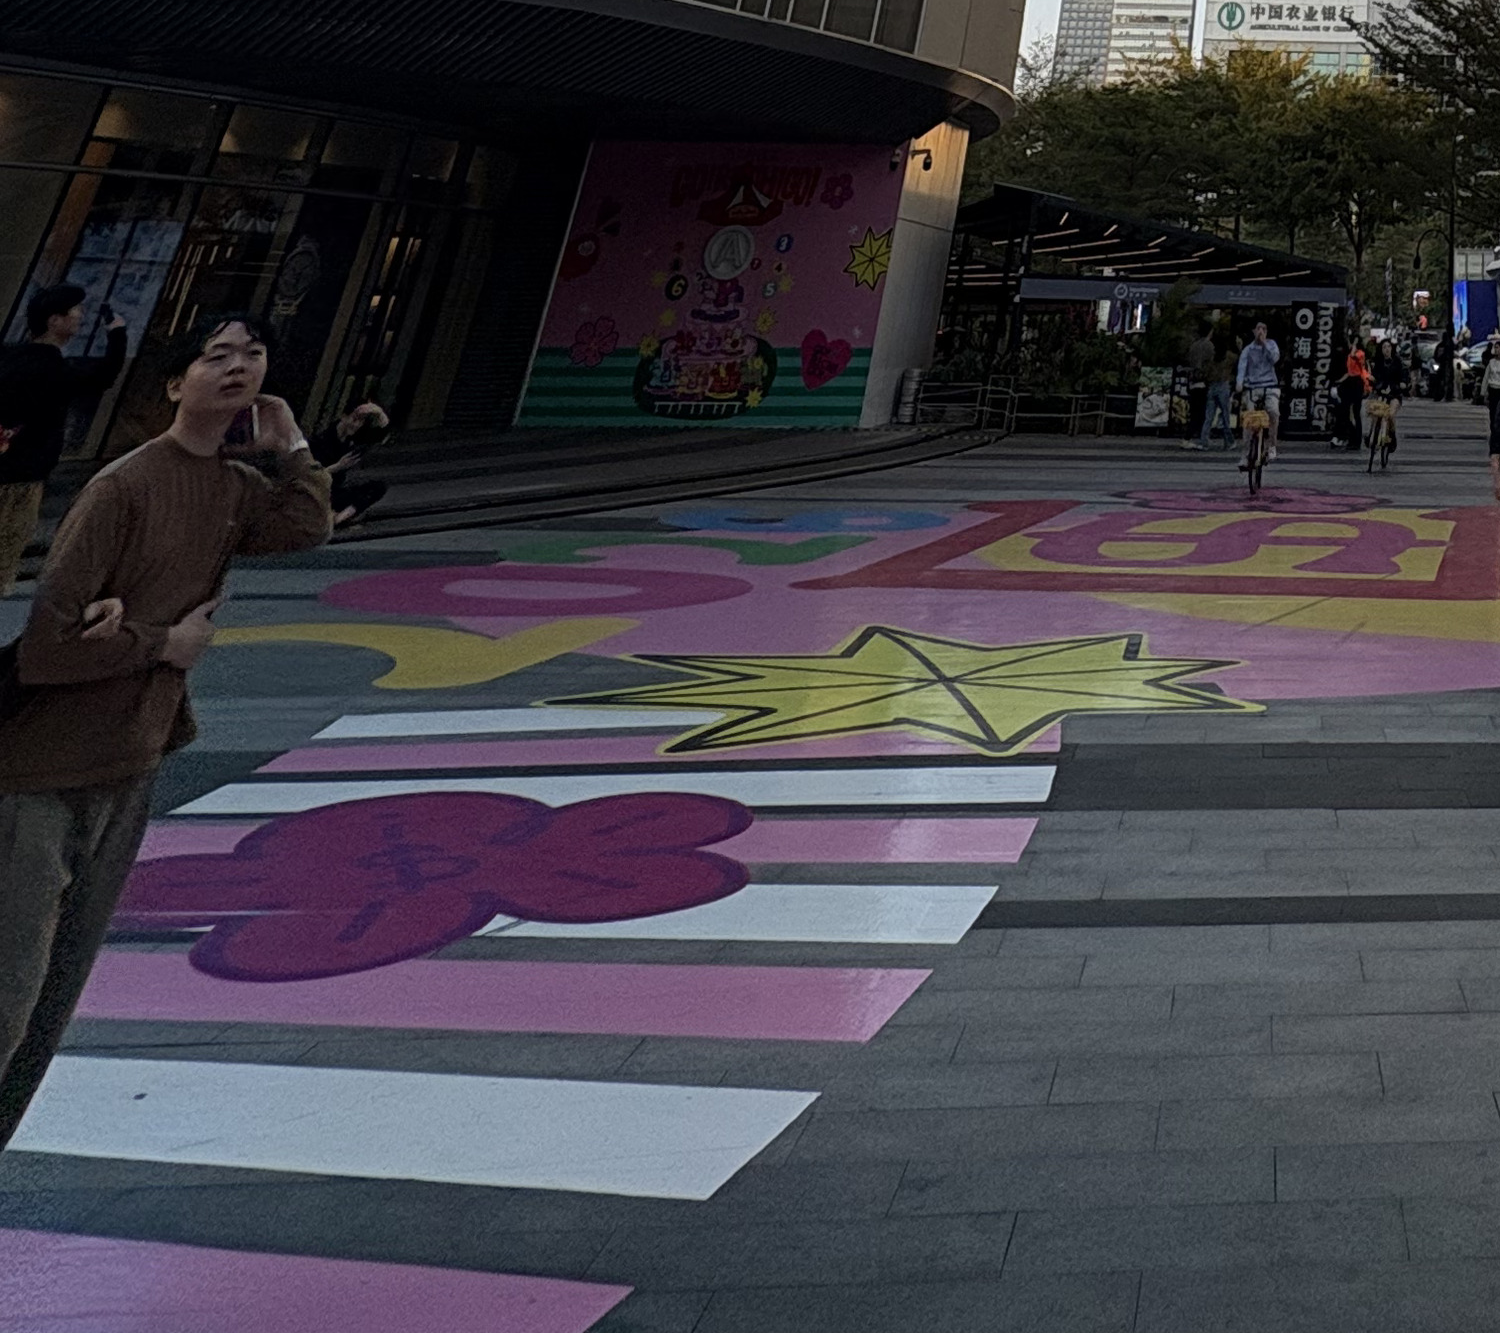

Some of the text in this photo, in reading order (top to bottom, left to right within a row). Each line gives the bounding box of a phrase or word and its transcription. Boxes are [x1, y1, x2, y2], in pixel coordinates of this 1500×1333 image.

[1250, 3, 1355, 22] 中国农业银行
[1289, 336, 1313, 421] 海森堡
